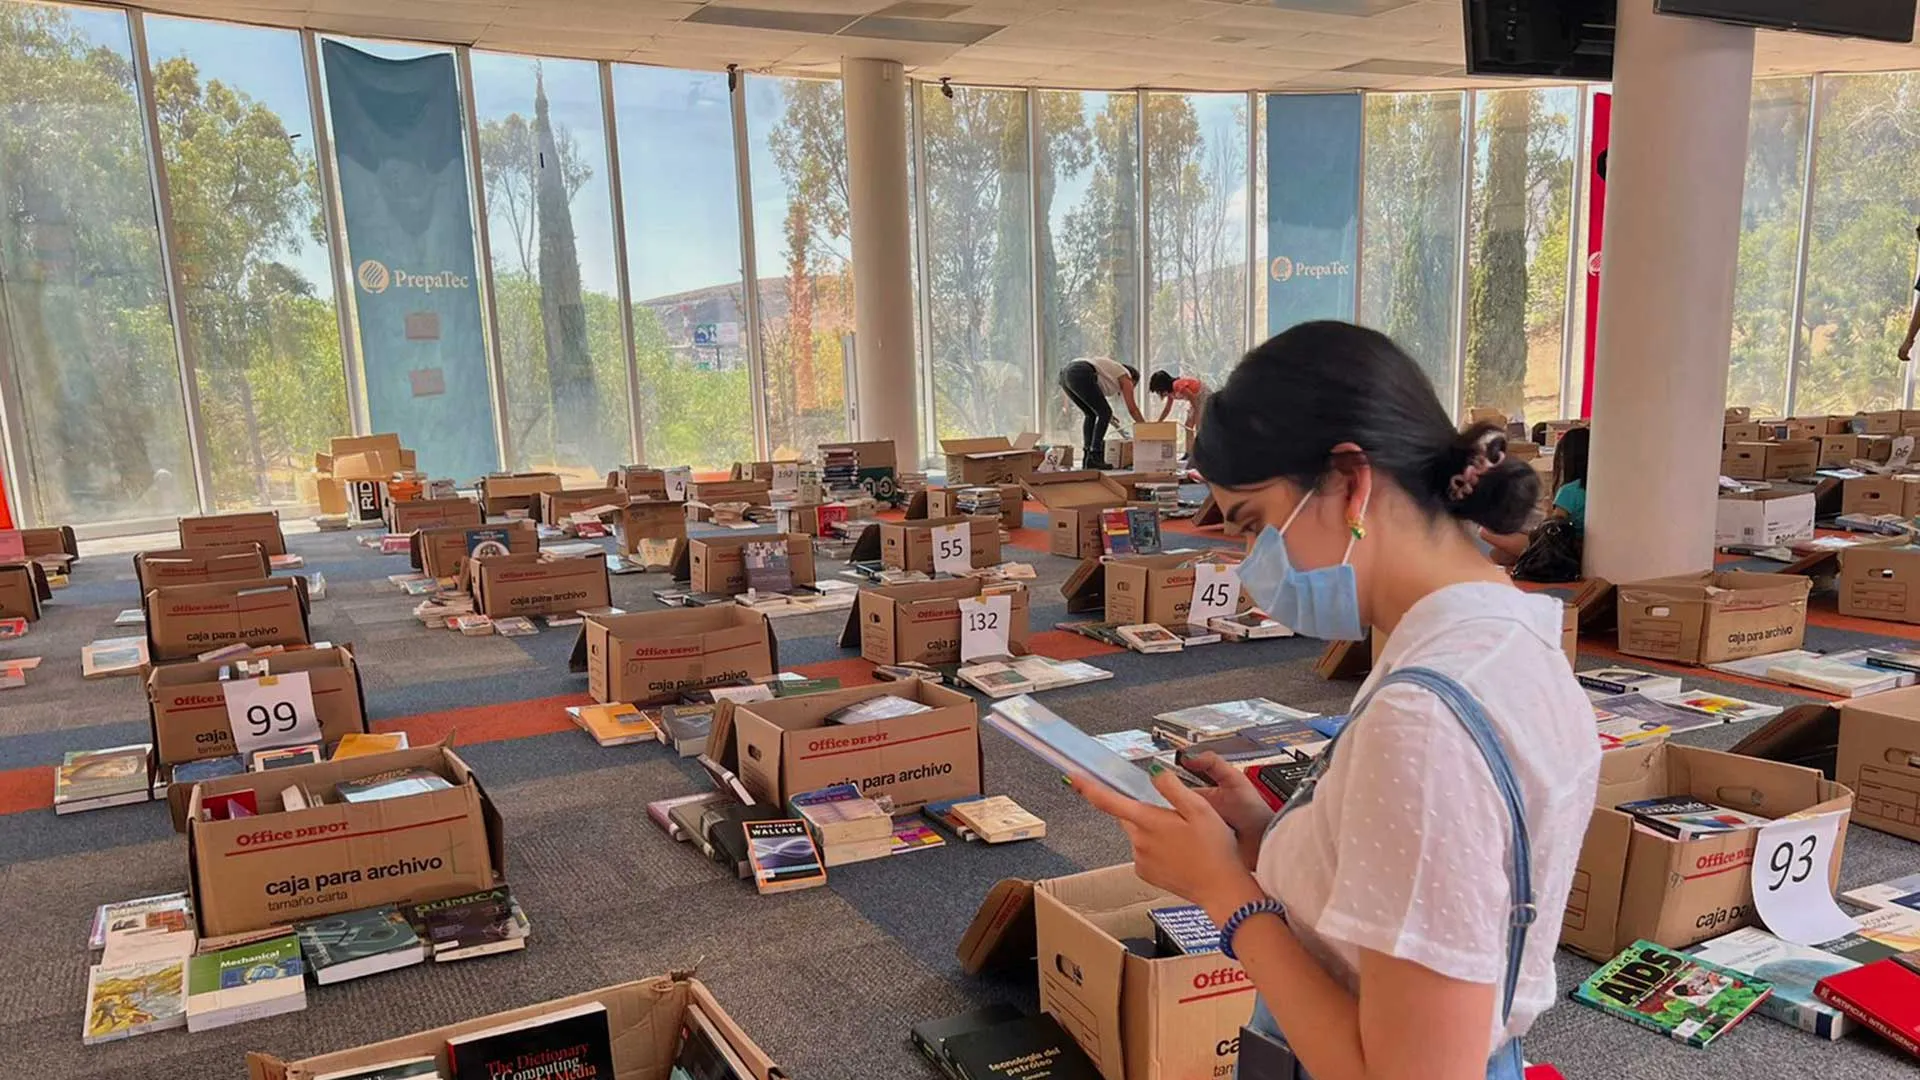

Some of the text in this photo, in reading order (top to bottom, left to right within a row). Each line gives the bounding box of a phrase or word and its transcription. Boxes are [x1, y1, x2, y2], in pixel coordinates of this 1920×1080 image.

[1295, 260, 1350, 280] PrepaTec
[393, 269, 469, 294] PrepaTec
[675, 481, 683, 492] 4
[940, 538, 963, 559] 55
[554, 589, 587, 602] archivo
[1201, 583, 1230, 607] 45
[969, 612, 998, 632] 132
[186, 626, 279, 643] caja para archivo
[926, 637, 948, 651] caja
[1728, 624, 1793, 645] caja para archivo
[636, 647, 669, 657] Office
[648, 669, 748, 693] caja para archivo
[173, 695, 215, 707] Office
[246, 701, 298, 737] 99
[195, 729, 228, 745] caja
[808, 732, 889, 752] Office DEPOT
[862, 772, 896, 792] para
[899, 761, 953, 783] archivo
[236, 821, 350, 847] Office DEPOT
[751, 826, 804, 836] WALLACE
[1696, 851, 1736, 870] Office
[1769, 835, 1817, 891] 93
[265, 856, 443, 897] caja para archivo
[267, 890, 349, 912] tamaño carta
[1695, 903, 1749, 930] caja pa
[220, 950, 281, 969] Mechanical
[1596, 948, 1684, 1006] AIDS
[1831, 995, 1868, 1022] ARTIFICIAL
[1868, 1017, 1919, 1053] INTELLIGENCE
[1216, 1036, 1241, 1057] ca
[486, 1060, 513, 1077] The
[517, 1043, 589, 1069] Dictionary
[501, 1057, 581, 1080] Computing
